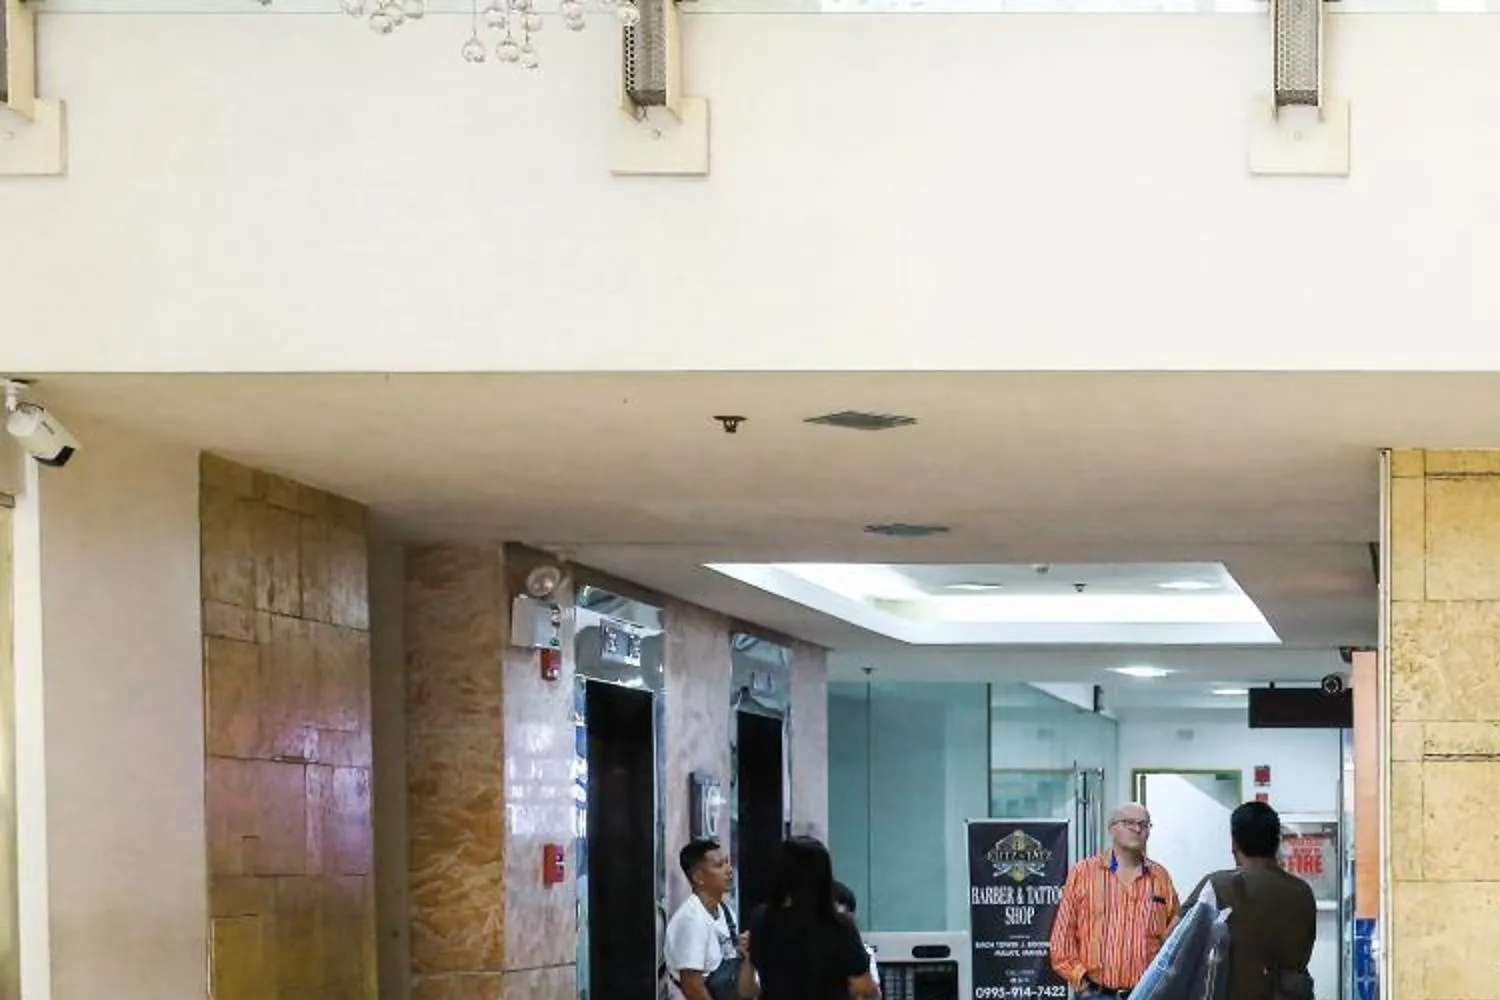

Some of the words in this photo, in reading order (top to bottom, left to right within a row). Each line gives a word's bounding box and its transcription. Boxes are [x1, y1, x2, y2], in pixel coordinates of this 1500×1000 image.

[1288, 855, 1324, 874] FIRE
[972, 885, 1014, 904] BARBER
[1016, 886, 1025, 904] &
[1005, 907, 1035, 926] SHOP
[975, 985, 1066, 999] 0995-914-7422
